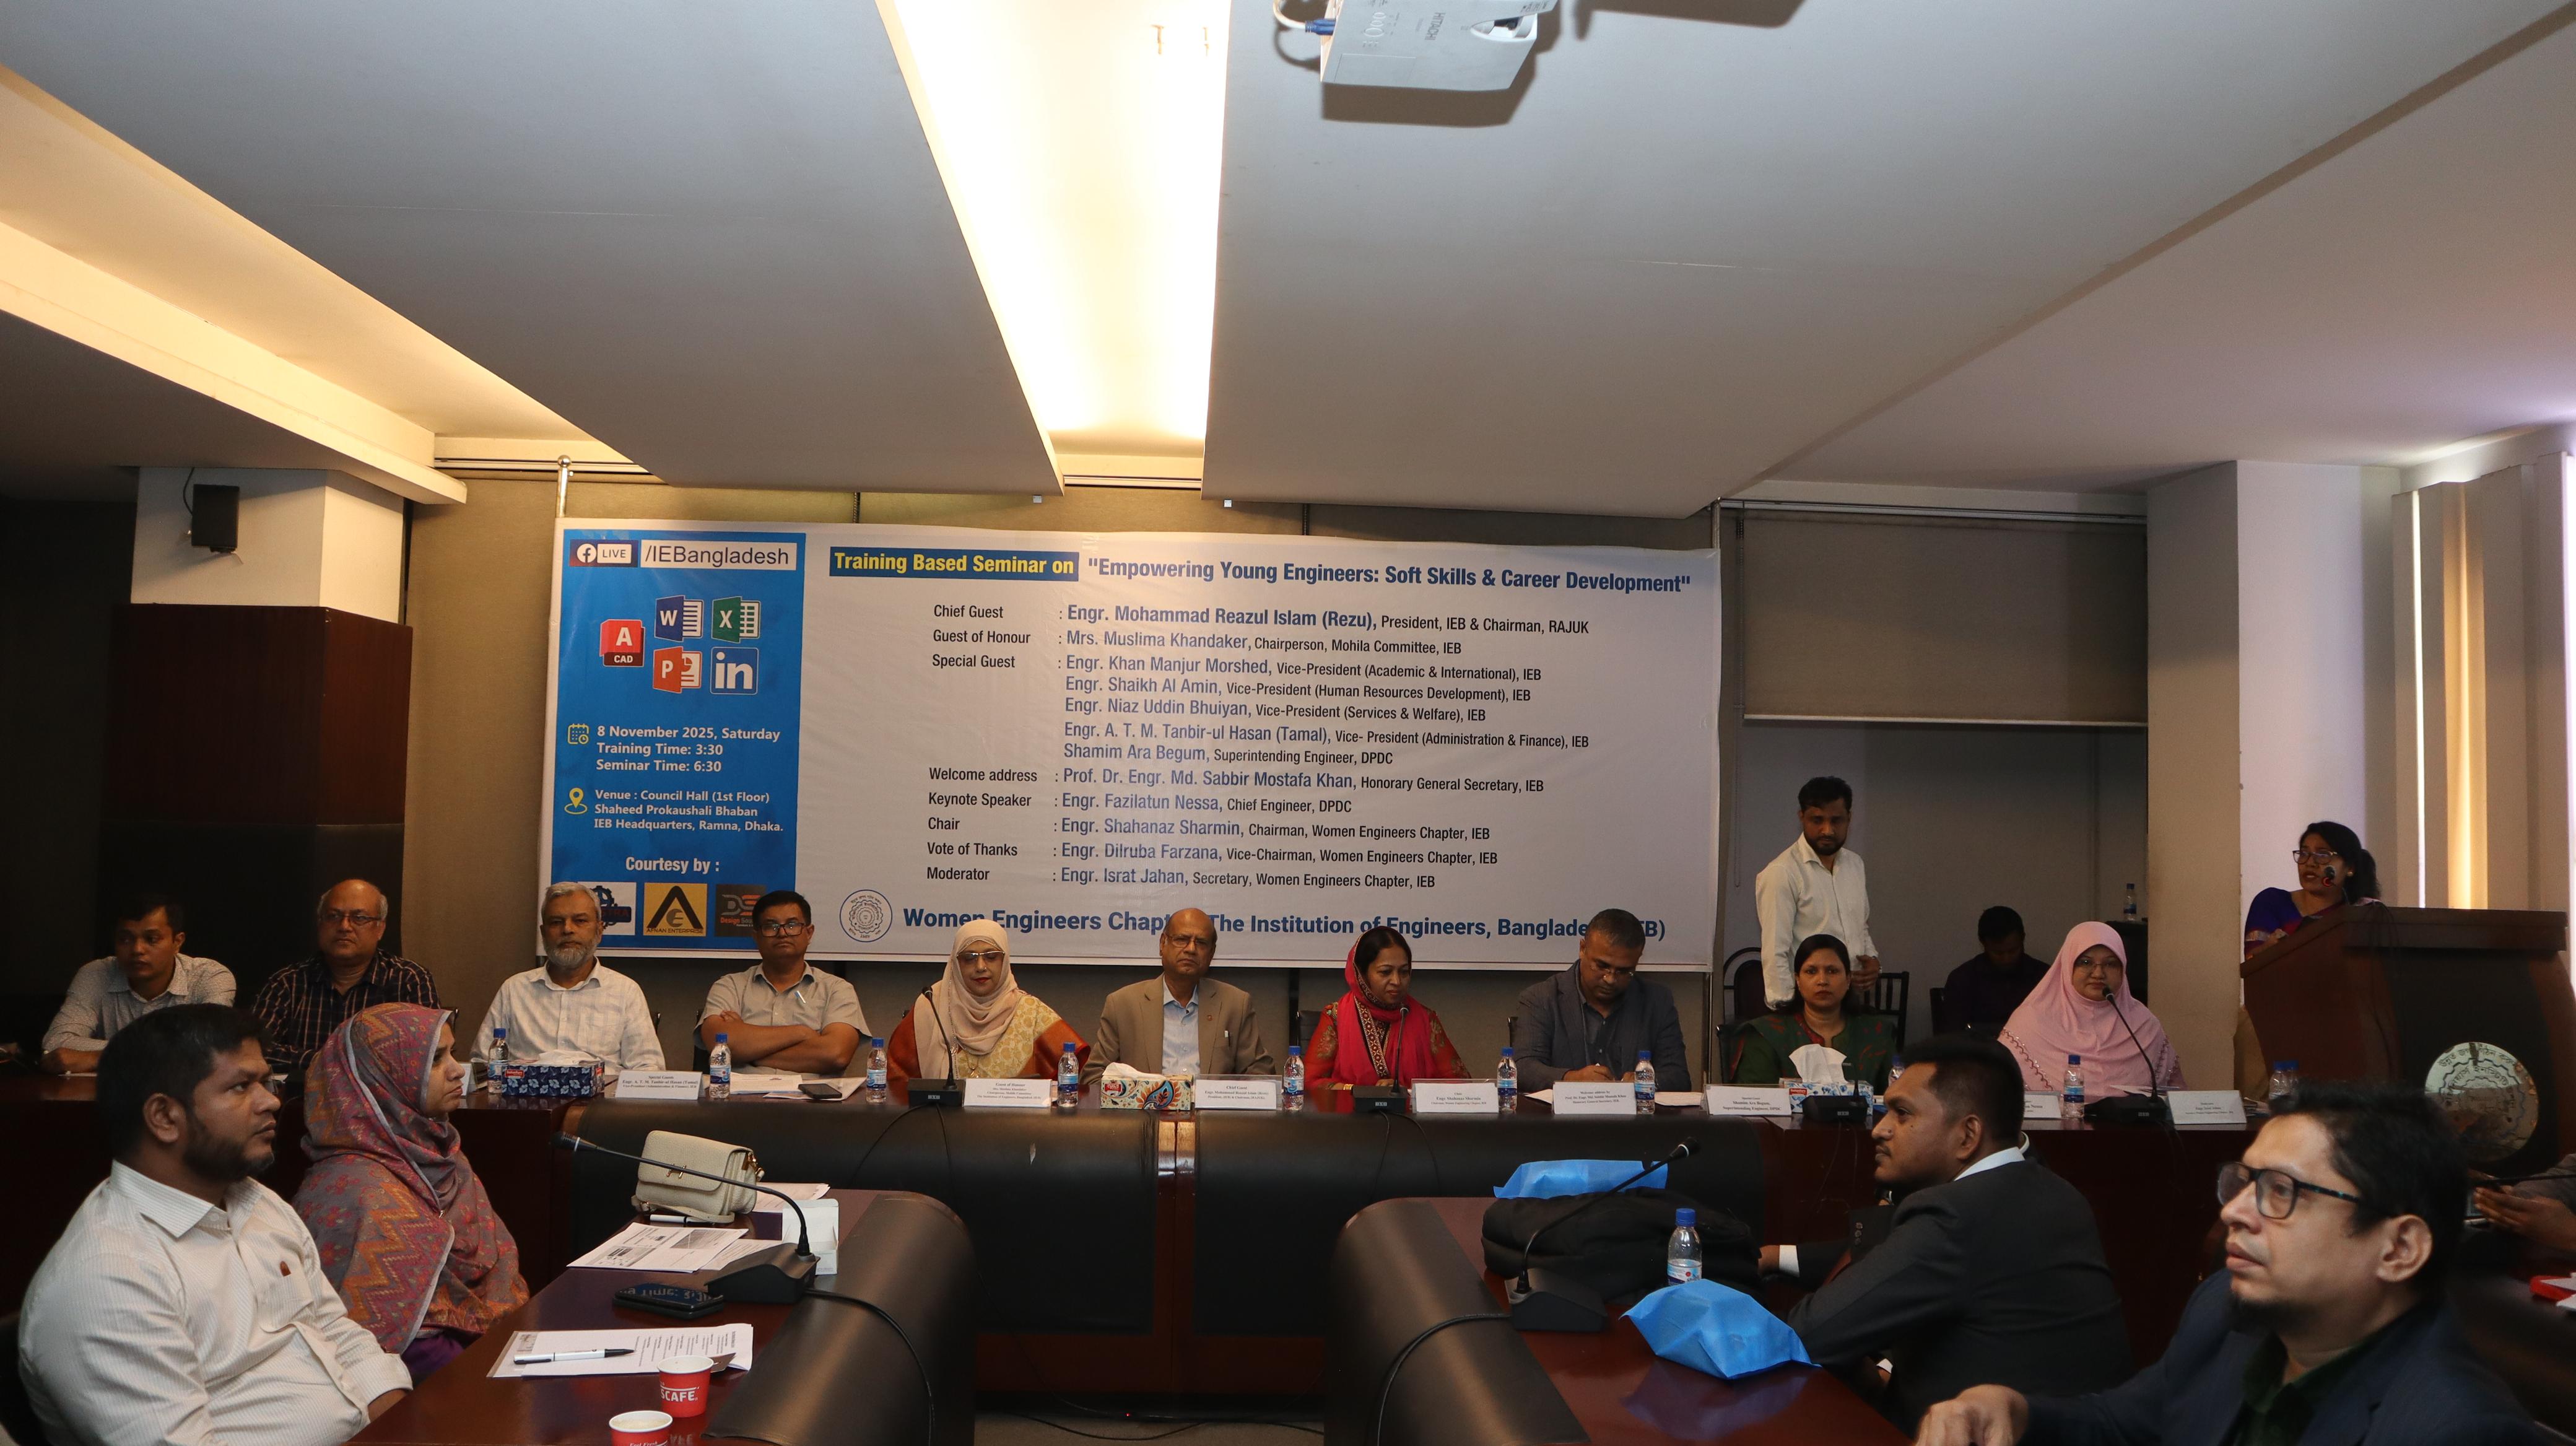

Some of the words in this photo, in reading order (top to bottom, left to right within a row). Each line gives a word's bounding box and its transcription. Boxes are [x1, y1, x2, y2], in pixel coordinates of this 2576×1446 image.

[1424, 12, 1447, 40] HITACHI
[601, 549, 627, 559] LIVE
[645, 544, 790, 568] /IEBangladesh
[834, 552, 907, 574] Training
[913, 554, 967, 572] Based
[973, 554, 1047, 573] Seminar
[1052, 560, 1074, 574] on
[1089, 557, 1214, 583] "Empowering
[1220, 560, 1277, 585] Young
[1283, 562, 1379, 586] Engineers:
[1385, 565, 1422, 585] Soft
[1427, 566, 1477, 586] Skills
[1481, 568, 1496, 587] &
[1501, 568, 1560, 589] Career
[1566, 571, 1690, 595] Development"
[659, 609, 678, 627] W
[719, 609, 733, 629] X
[934, 604, 965, 618] Chief
[968, 605, 1004, 619] Guest
[1068, 604, 1109, 625] Engr.
[1115, 605, 1209, 624] Mohammad
[1215, 608, 1268, 625] Reazul
[1274, 609, 1316, 626] Islam
[1322, 610, 1377, 632] (Rezu),
[1382, 614, 1442, 632] President,
[1447, 616, 1466, 630] IEB
[1469, 617, 1479, 631] &
[1483, 617, 1544, 635] Chairman,
[1549, 619, 1589, 634] RAJUK
[616, 627, 633, 646] A
[933, 629, 968, 643] Guest
[971, 629, 984, 643] of
[987, 630, 1031, 644] Honour
[1067, 629, 1098, 646] Mrs.
[1104, 630, 1165, 647] Muslima
[1170, 632, 1251, 652] Khandaker,
[1254, 636, 1328, 653] Chairperson,
[1331, 638, 1370, 653] Mohila
[1373, 639, 1439, 656] Committee,
[1443, 641, 1462, 655] IEB
[614, 655, 633, 664] CAD
[932, 653, 977, 669] Special
[980, 654, 1016, 668] Guest
[1066, 654, 1103, 673] Engr.
[1109, 655, 1145, 671] Khan
[1150, 656, 1201, 676] Manjur
[1206, 657, 1272, 677] Morshed,
[1276, 661, 1362, 677] Vice-President
[1364, 663, 1425, 679] (Academic
[1428, 665, 1437, 679] &
[1441, 665, 1519, 683] International),
[1523, 668, 1541, 681] IEB
[661, 660, 674, 679] P
[715, 651, 754, 689] in
[597, 725, 606, 738] 8
[609, 725, 679, 738] November
[682, 726, 718, 740] 2025,
[721, 727, 781, 743] Saturday
[596, 741, 651, 758] Training
[655, 743, 691, 756] Time:
[695, 743, 723, 756] 3:30
[1064, 743, 1122, 759] Shamim
[1127, 744, 1151, 760] Ara
[1156, 744, 1209, 764] Begum,
[1214, 748, 1300, 765] Superintending
[1304, 750, 1357, 767] Engineer,
[1361, 751, 1393, 765] DPDC
[596, 758, 651, 771] Seminar
[653, 759, 690, 772] Time:
[694, 760, 722, 772] 6:30
[929, 767, 985, 782] Welcome
[989, 768, 1037, 782] address
[1063, 767, 1097, 783] Prof.
[1102, 768, 1123, 784] Dr.
[1128, 769, 1165, 788] Engr.
[1171, 769, 1198, 785] Md.
[1203, 770, 1250, 786] Sabbir
[1254, 771, 1312, 788] Mostafa
[1316, 772, 1357, 791] Khan,
[1361, 775, 1414, 793] Honorary
[1417, 777, 1460, 791] General
[1464, 778, 1521, 794] Secretary,
[1526, 779, 1544, 792] IEB
[594, 789, 632, 800] Venue
[640, 790, 683, 801] Council
[686, 790, 708, 801] Hall
[712, 791, 734, 803] (1st
[736, 791, 770, 804] Floor)
[928, 791, 978, 808] Keynote
[981, 792, 1032, 809] Speaker
[1062, 792, 1099, 811] Engr.
[1105, 793, 1170, 810] Fazilatun
[1175, 794, 1222, 814] Nessa,
[1227, 797, 1258, 811] Chief
[1260, 798, 1315, 815] Engineer,
[1319, 799, 1352, 813] DPDC
[594, 803, 643, 814] Shaheed
[646, 804, 712, 816] Prokaushali
[715, 805, 758, 817] Bhaban
[594, 818, 612, 829] IEB
[616, 818, 695, 832] Headquarters,
[699, 820, 741, 832] Ramna,
[744, 820, 783, 832] Dhaka.
[928, 816, 960, 830] Chair
[927, 842, 954, 855] Vote
[957, 842, 970, 855] of
[973, 842, 1018, 856] Thanks
[625, 856, 689, 874] Courtesy
[693, 857, 711, 875] by
[926, 866, 990, 881] Moderator
[720, 917, 741, 925] Design
[993, 910, 1102, 933] Engineers
[1108, 912, 1170, 936] Chap
[1251, 915, 1354, 934] Institution
[1360, 916, 1381, 933] of
[1387, 917, 1492, 939] Engineers,
[1497, 917, 1588, 940] Banglade
[661, 1389, 695, 1402] SCAFE
